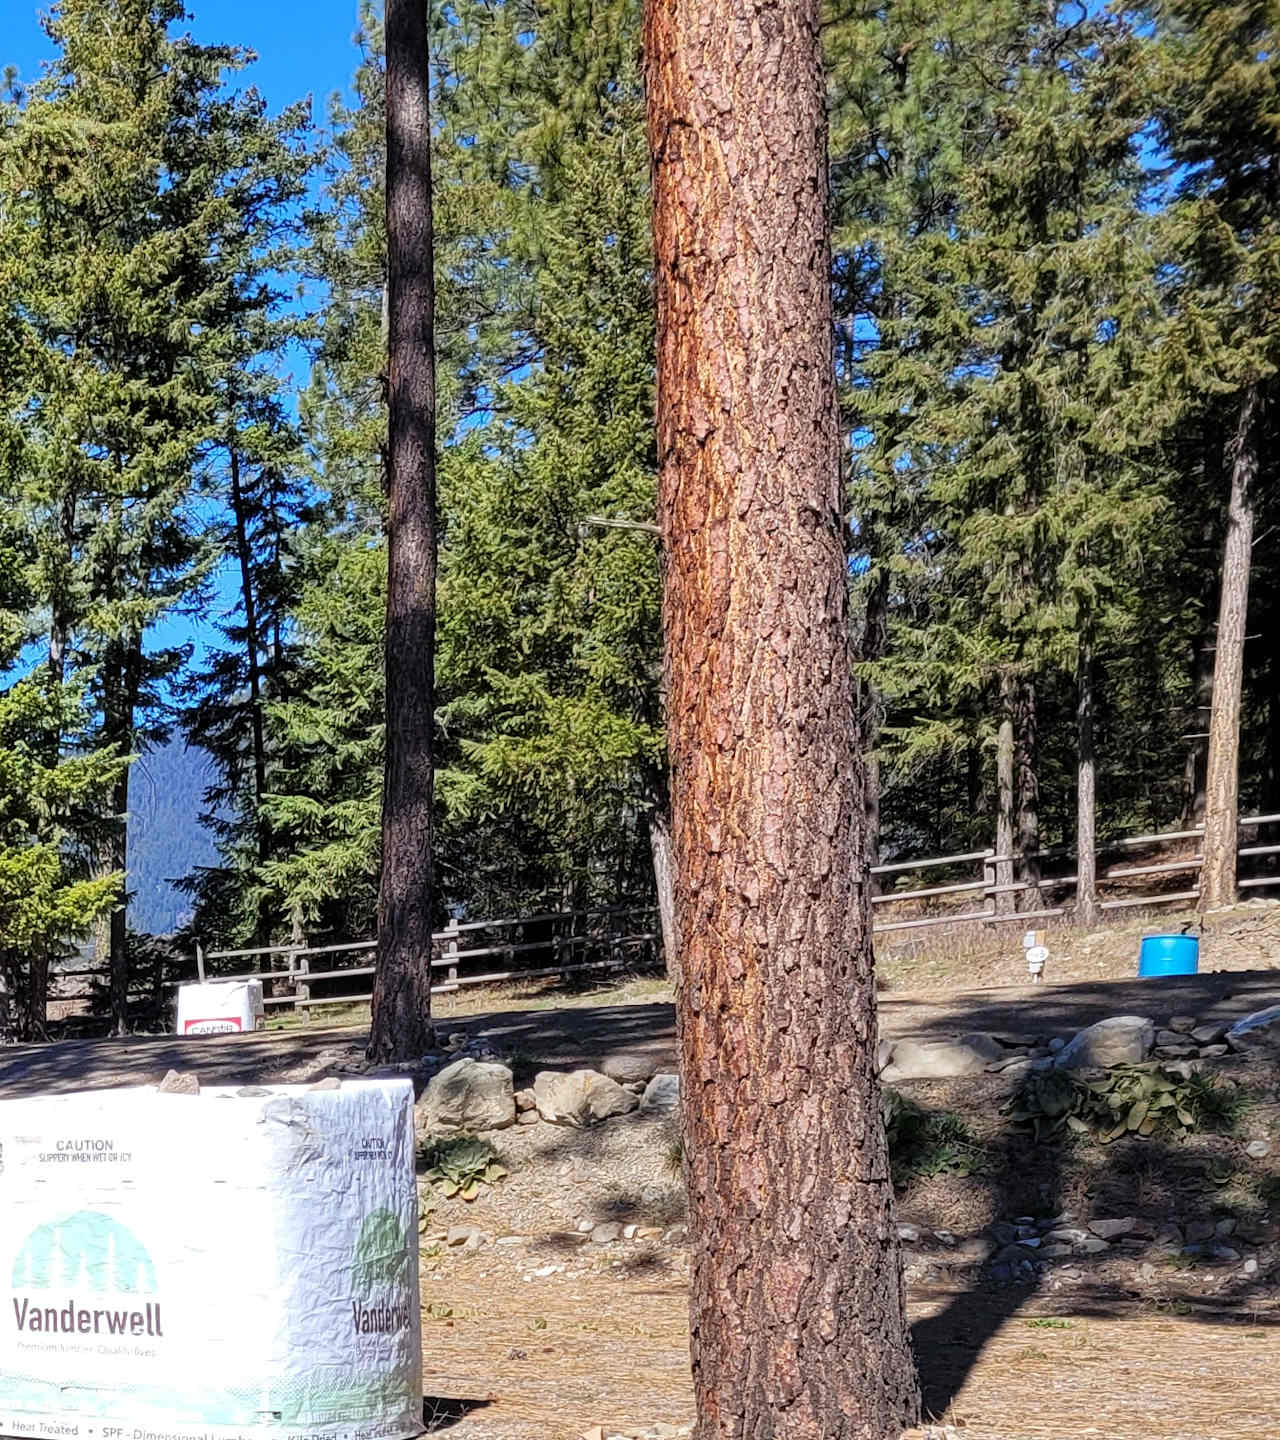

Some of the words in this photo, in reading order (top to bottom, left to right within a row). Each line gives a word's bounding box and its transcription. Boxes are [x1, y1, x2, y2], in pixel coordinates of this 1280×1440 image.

[56, 1139, 113, 1151] CAUTION
[13, 1297, 163, 1336] Vanderwell
[12, 1420, 35, 1432] Heat
[40, 1422, 79, 1436] Treated
[102, 1427, 123, 1438] SPF
